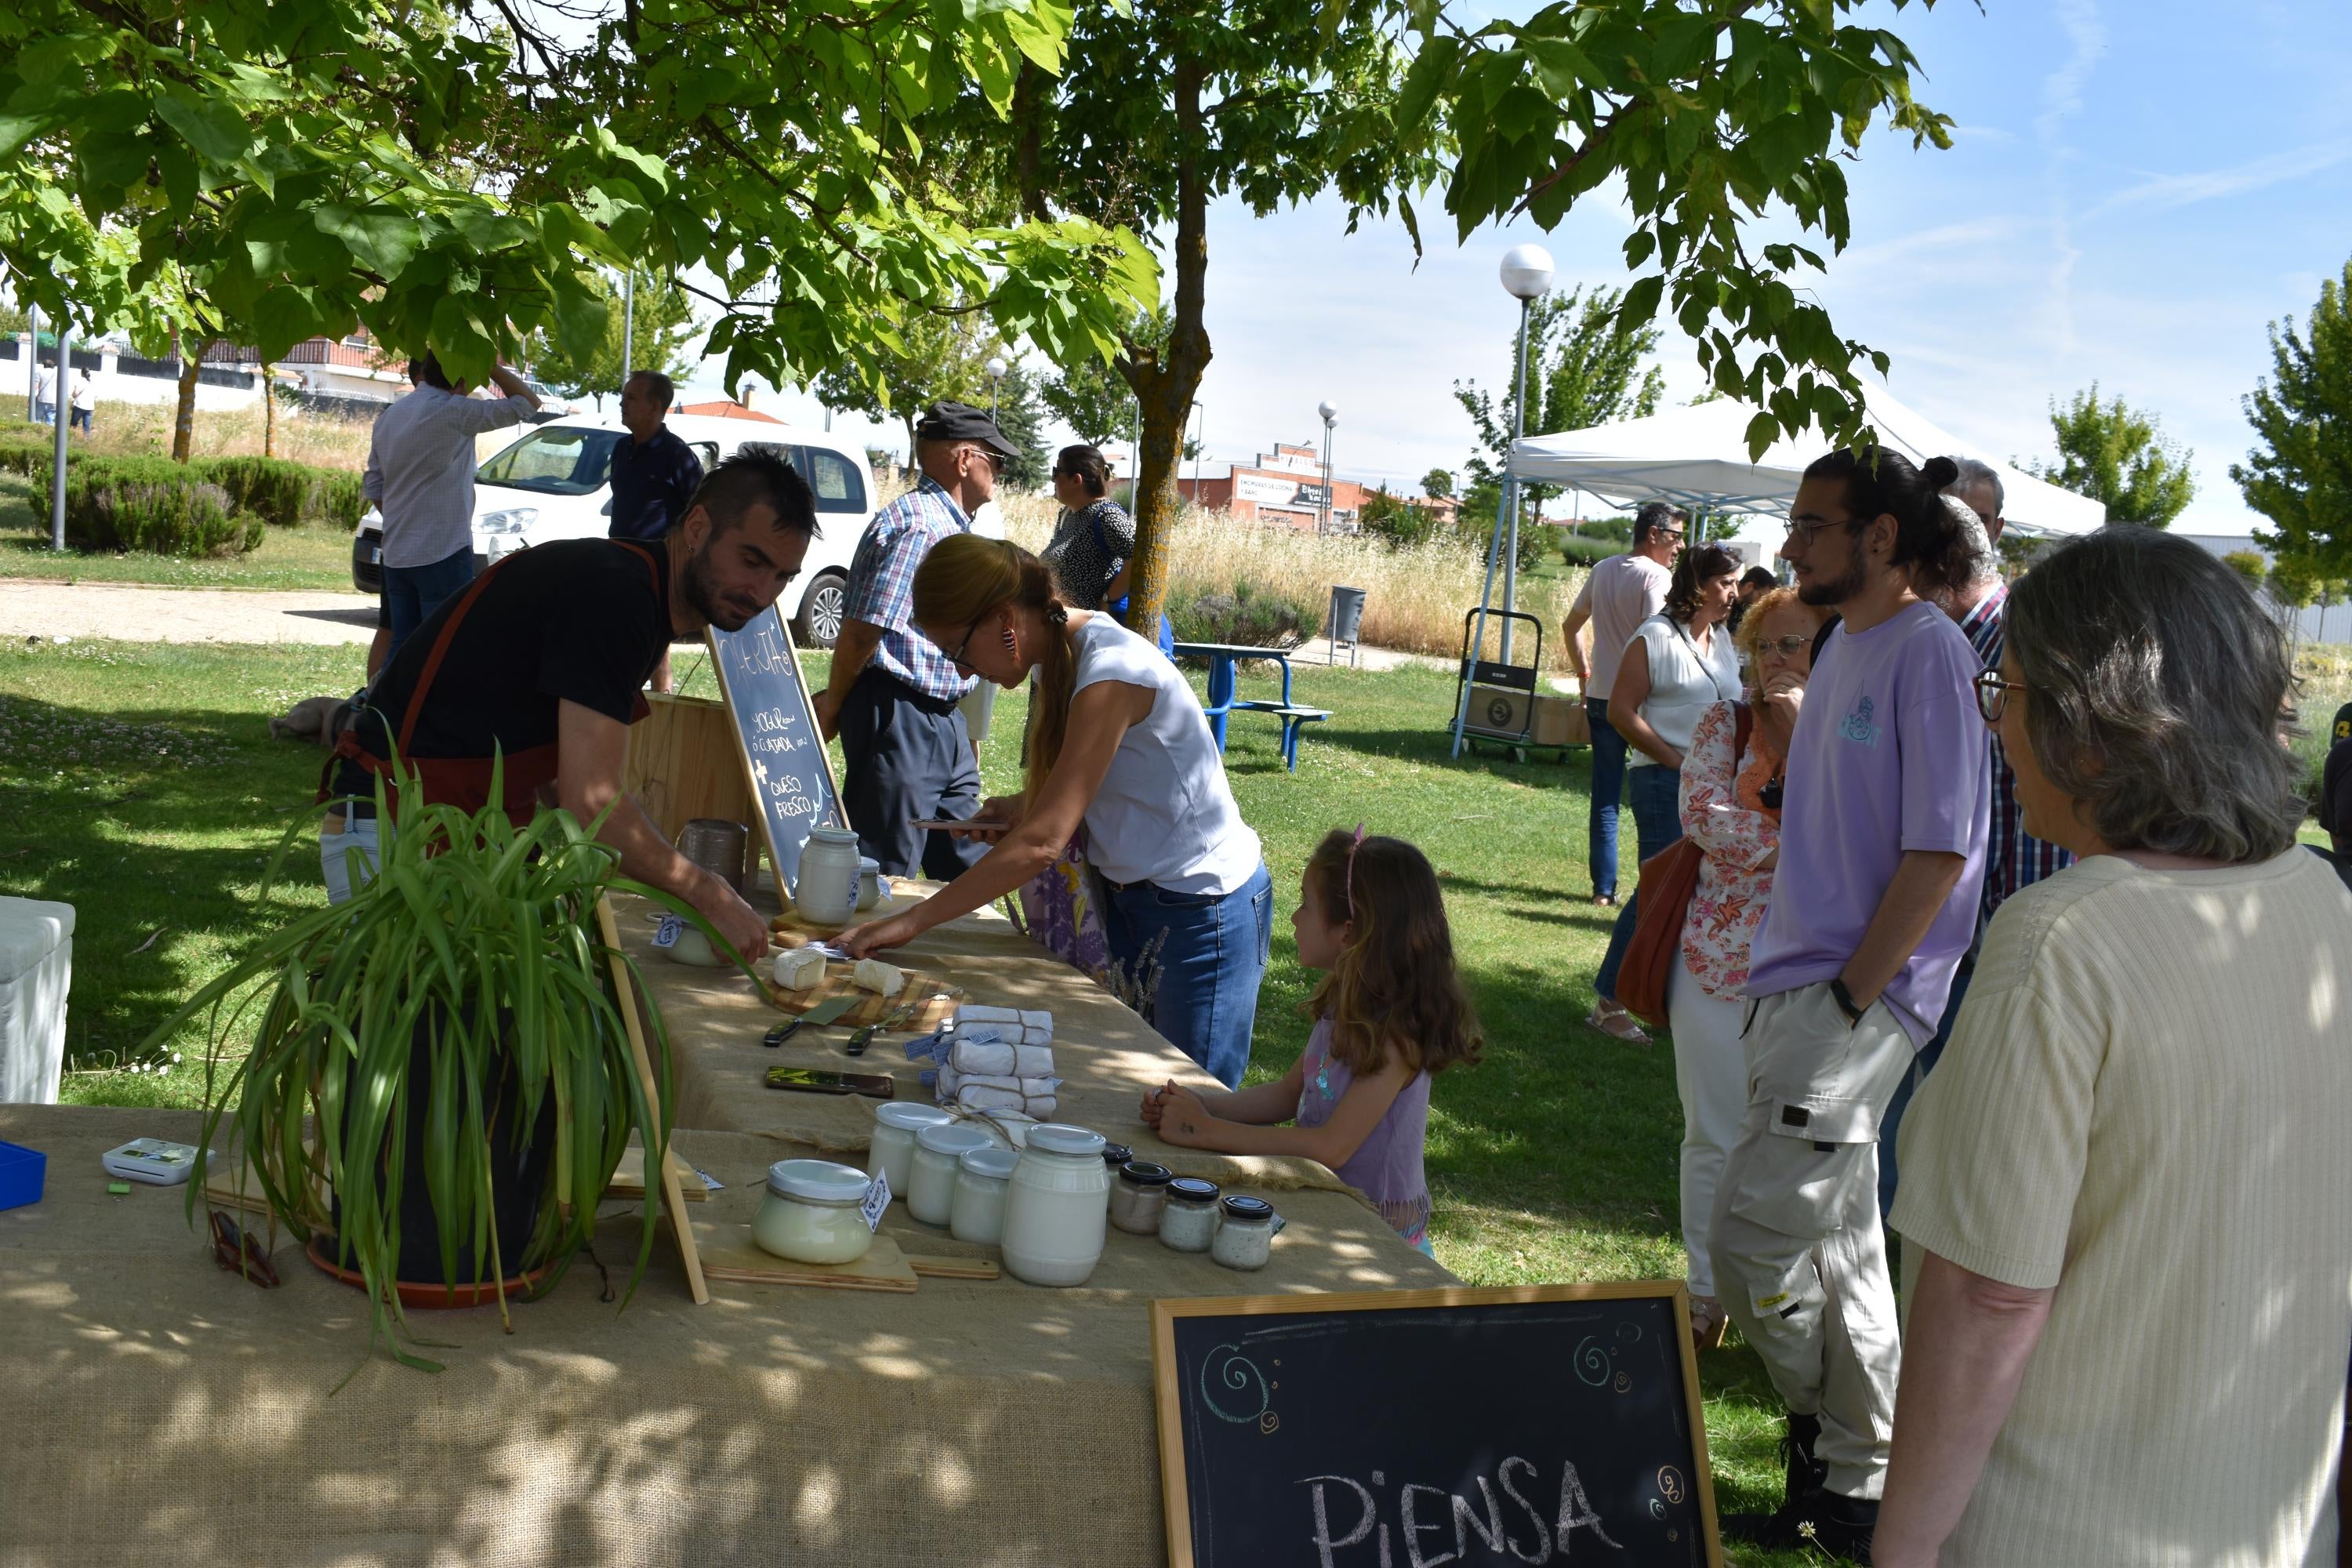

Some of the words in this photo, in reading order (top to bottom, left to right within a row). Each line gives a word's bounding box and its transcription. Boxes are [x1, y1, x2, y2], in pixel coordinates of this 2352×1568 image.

[752, 708, 788, 733] YOGUR
[759, 737, 796, 753] CUAJADA
[771, 775, 801, 796] QUESO
[775, 796, 811, 819] FRESCO
